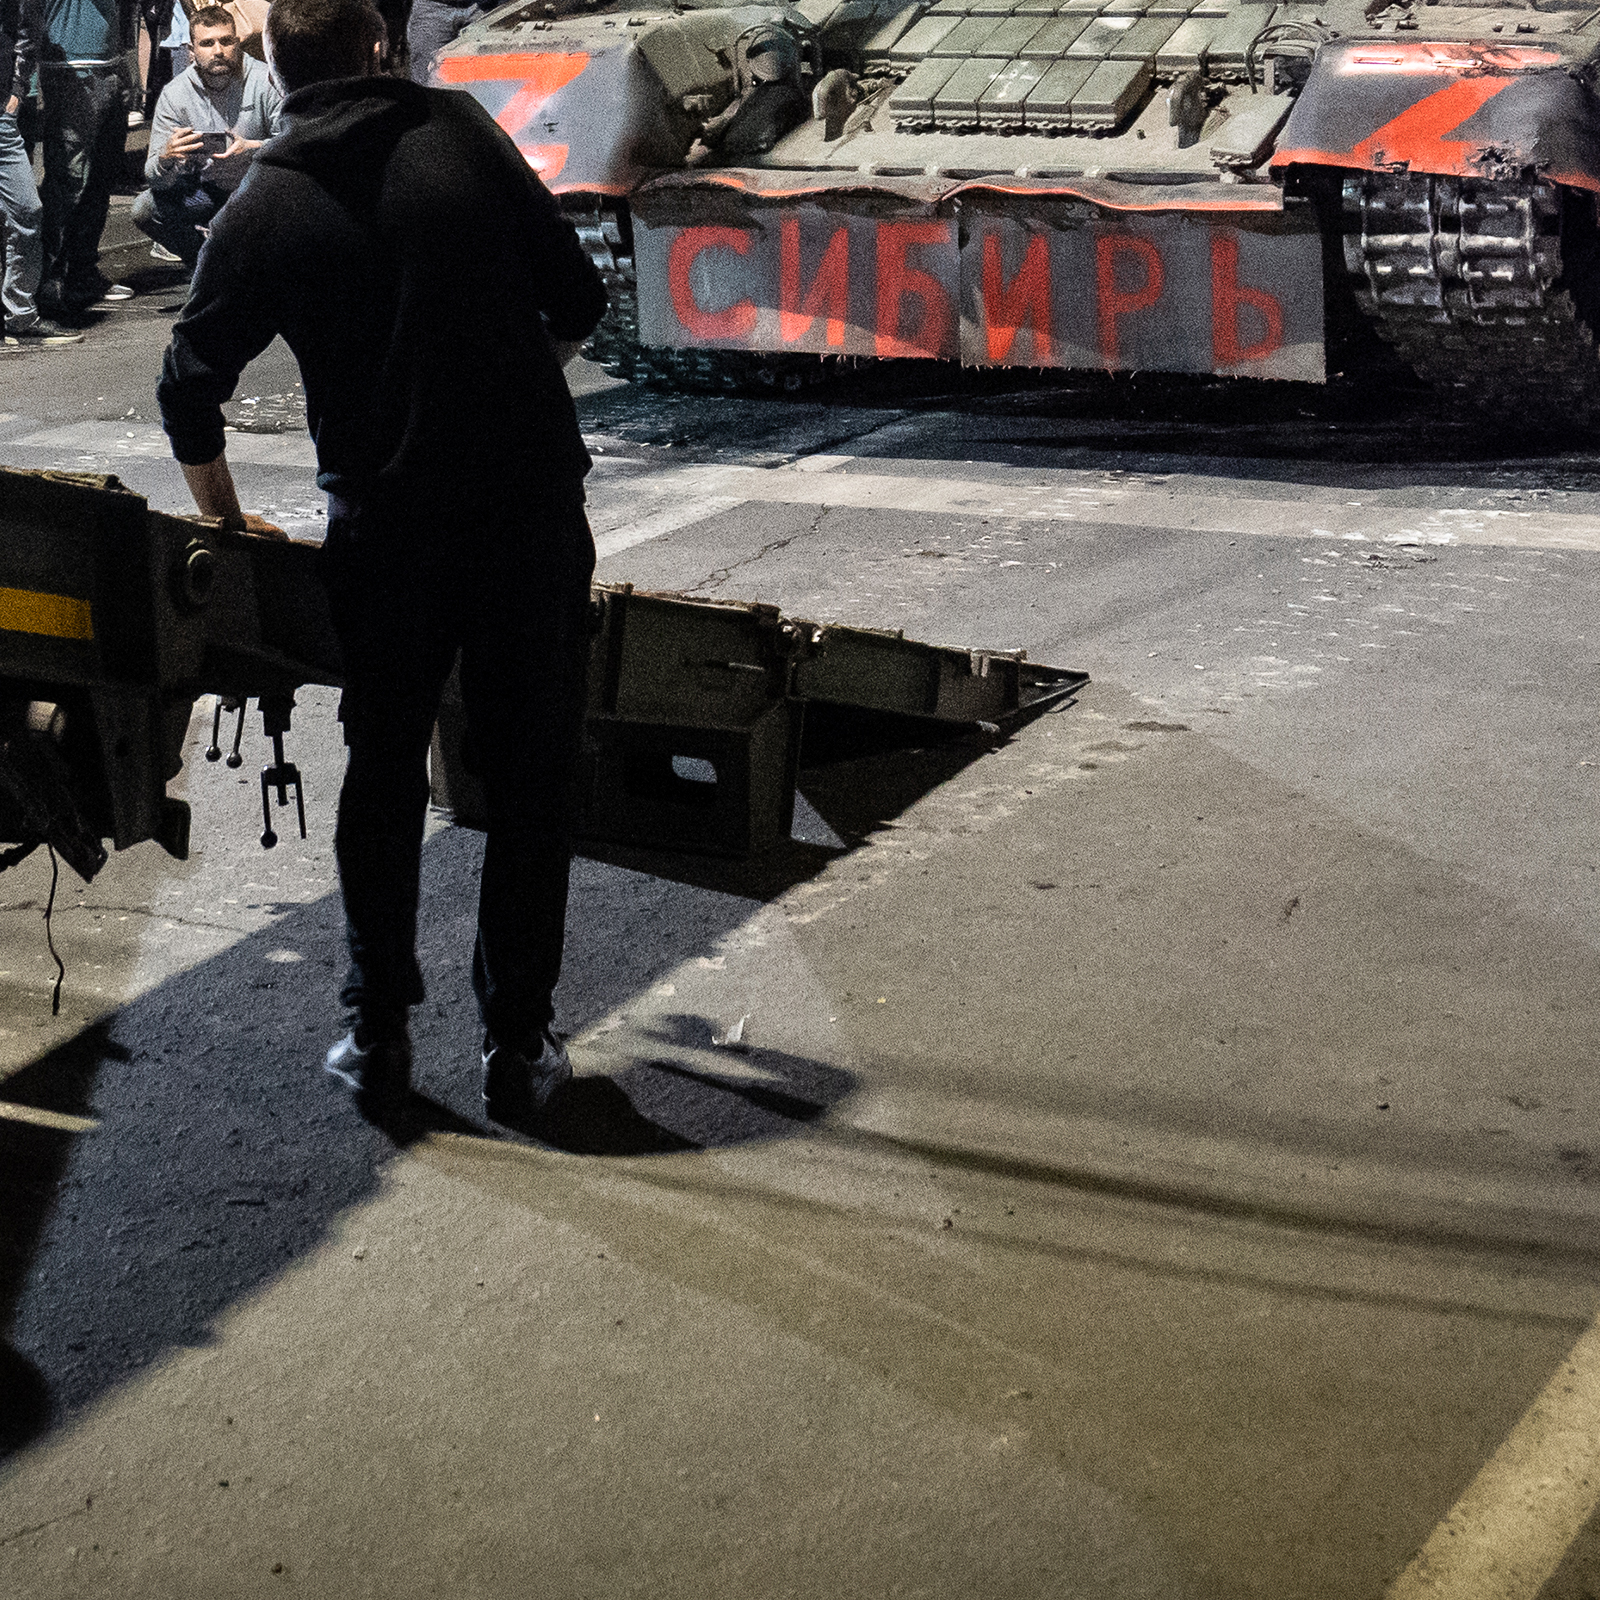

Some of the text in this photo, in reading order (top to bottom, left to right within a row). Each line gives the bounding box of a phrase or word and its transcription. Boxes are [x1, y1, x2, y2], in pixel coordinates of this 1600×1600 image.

[436, 51, 593, 182] Z
[1325, 42, 1562, 180] Z
[666, 217, 1284, 366] СИБИРЬ
